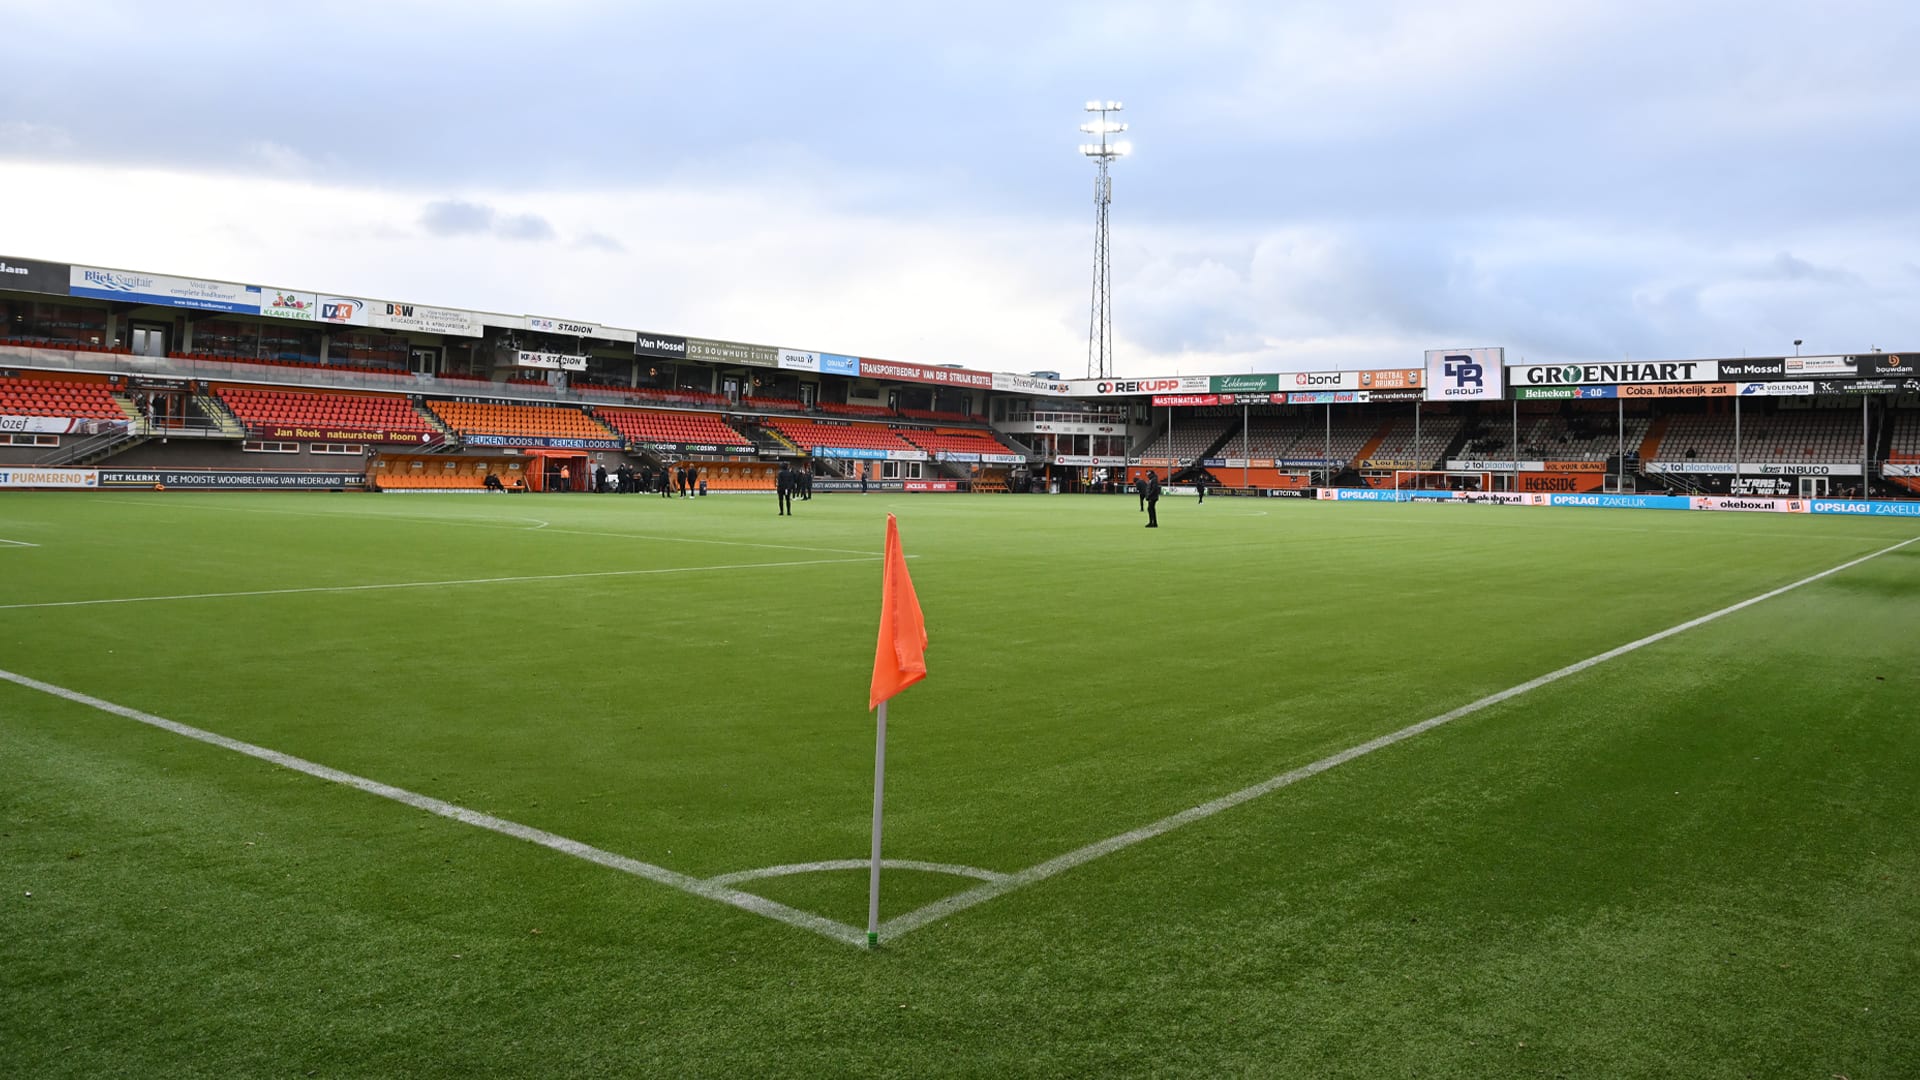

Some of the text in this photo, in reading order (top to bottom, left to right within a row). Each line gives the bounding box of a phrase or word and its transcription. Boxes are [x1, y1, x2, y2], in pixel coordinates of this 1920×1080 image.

[386, 303, 414, 318] DSW
[558, 322, 593, 335] STADION
[639, 336, 656, 348] Van
[656, 338, 685, 353] Mossel
[687, 345, 702, 354] JOS
[705, 346, 748, 359] BOUWHUIS
[751, 352, 778, 361] TUINEN
[860, 362, 921, 378] TRANSPORTBEDRIJF
[923, 369, 934, 380] VAN
[935, 371, 948, 382] DER
[1527, 363, 1697, 384] GROENHART
[1721, 364, 1743, 375] Van
[1744, 362, 1782, 374] Mossel
[1876, 365, 1913, 374] bouwdam
[1307, 372, 1341, 386] bond
[1375, 371, 1405, 380] VOETBAL
[1375, 379, 1404, 388] DRUKKER
[1445, 388, 1483, 396] GROUP
[1525, 388, 1571, 398] Heineken
[1657, 385, 1707, 397] Makkelijk
[1711, 385, 1727, 394] zat
[274, 427, 417, 442] Jan Reek natuursteen Hoorn
[1472, 461, 1484, 469] tol
[1670, 462, 1733, 474] tol plaatwerk
[1783, 465, 1829, 475] INBUCO
[12, 473, 81, 483] PURMEREND
[103, 474, 361, 485] PIET KLERKX DE MOOISTE WOONBELEVING VAN NEDERLAND PIET
[1730, 478, 1776, 488] ULTRAS
[1340, 491, 1378, 500] OPSLAG!
[1554, 495, 1646, 507] OPSLAG! ZAKELIJK
[1720, 499, 1775, 510] okebox.nl
[1814, 502, 1870, 513] OPSLAG!
